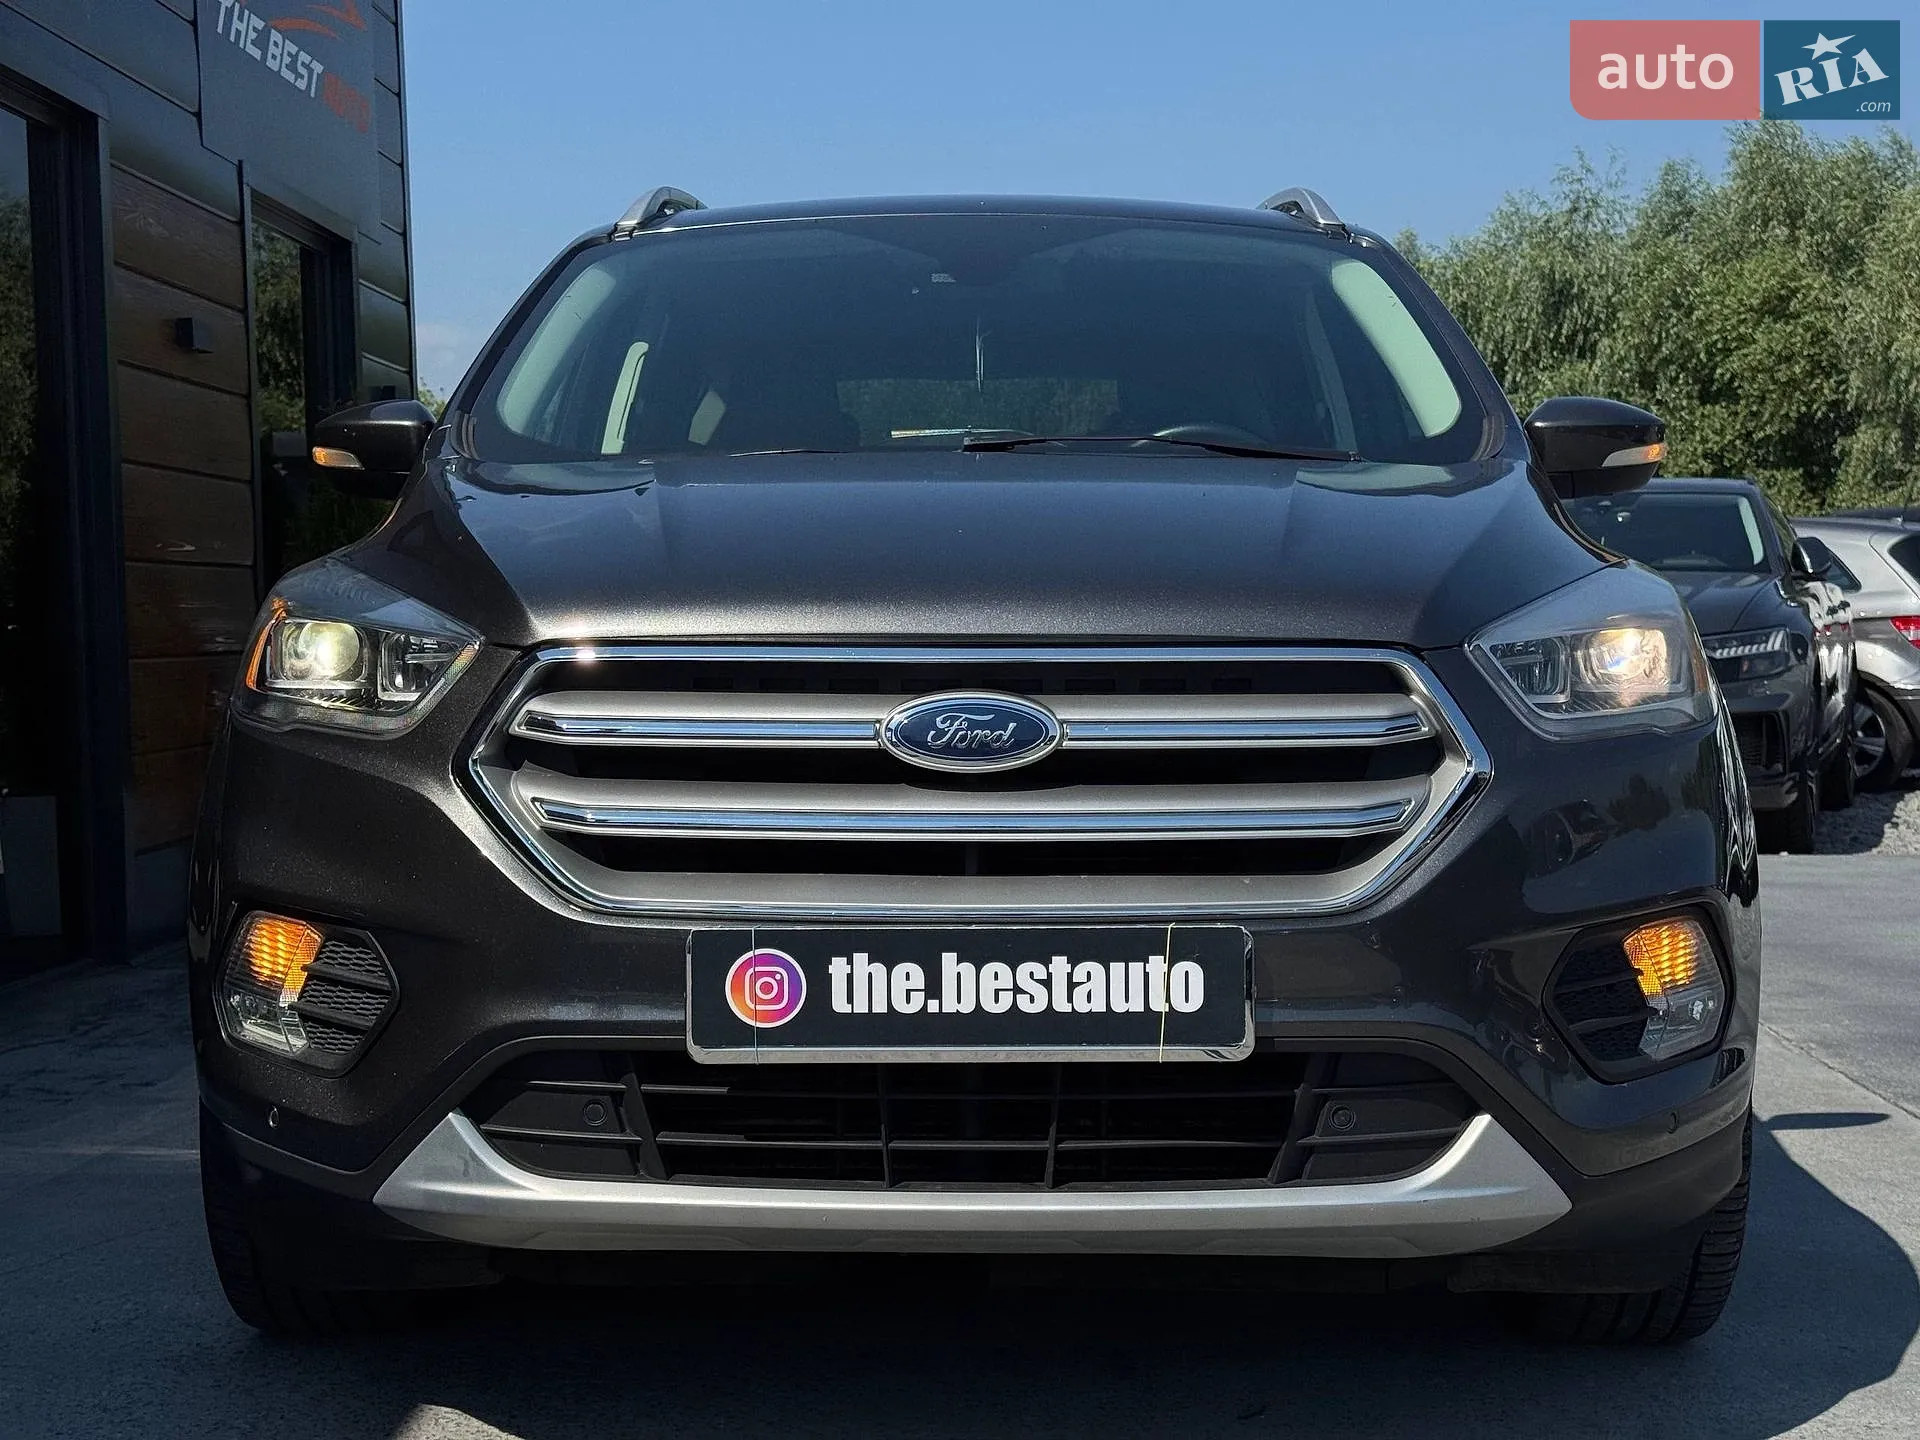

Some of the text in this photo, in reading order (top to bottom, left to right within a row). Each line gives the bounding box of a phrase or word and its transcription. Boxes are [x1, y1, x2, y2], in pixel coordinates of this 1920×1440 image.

[217, 0, 324, 98] THE BEST
[927, 712, 1017, 749] Ford
[828, 952, 1204, 1014] the.bestauto
